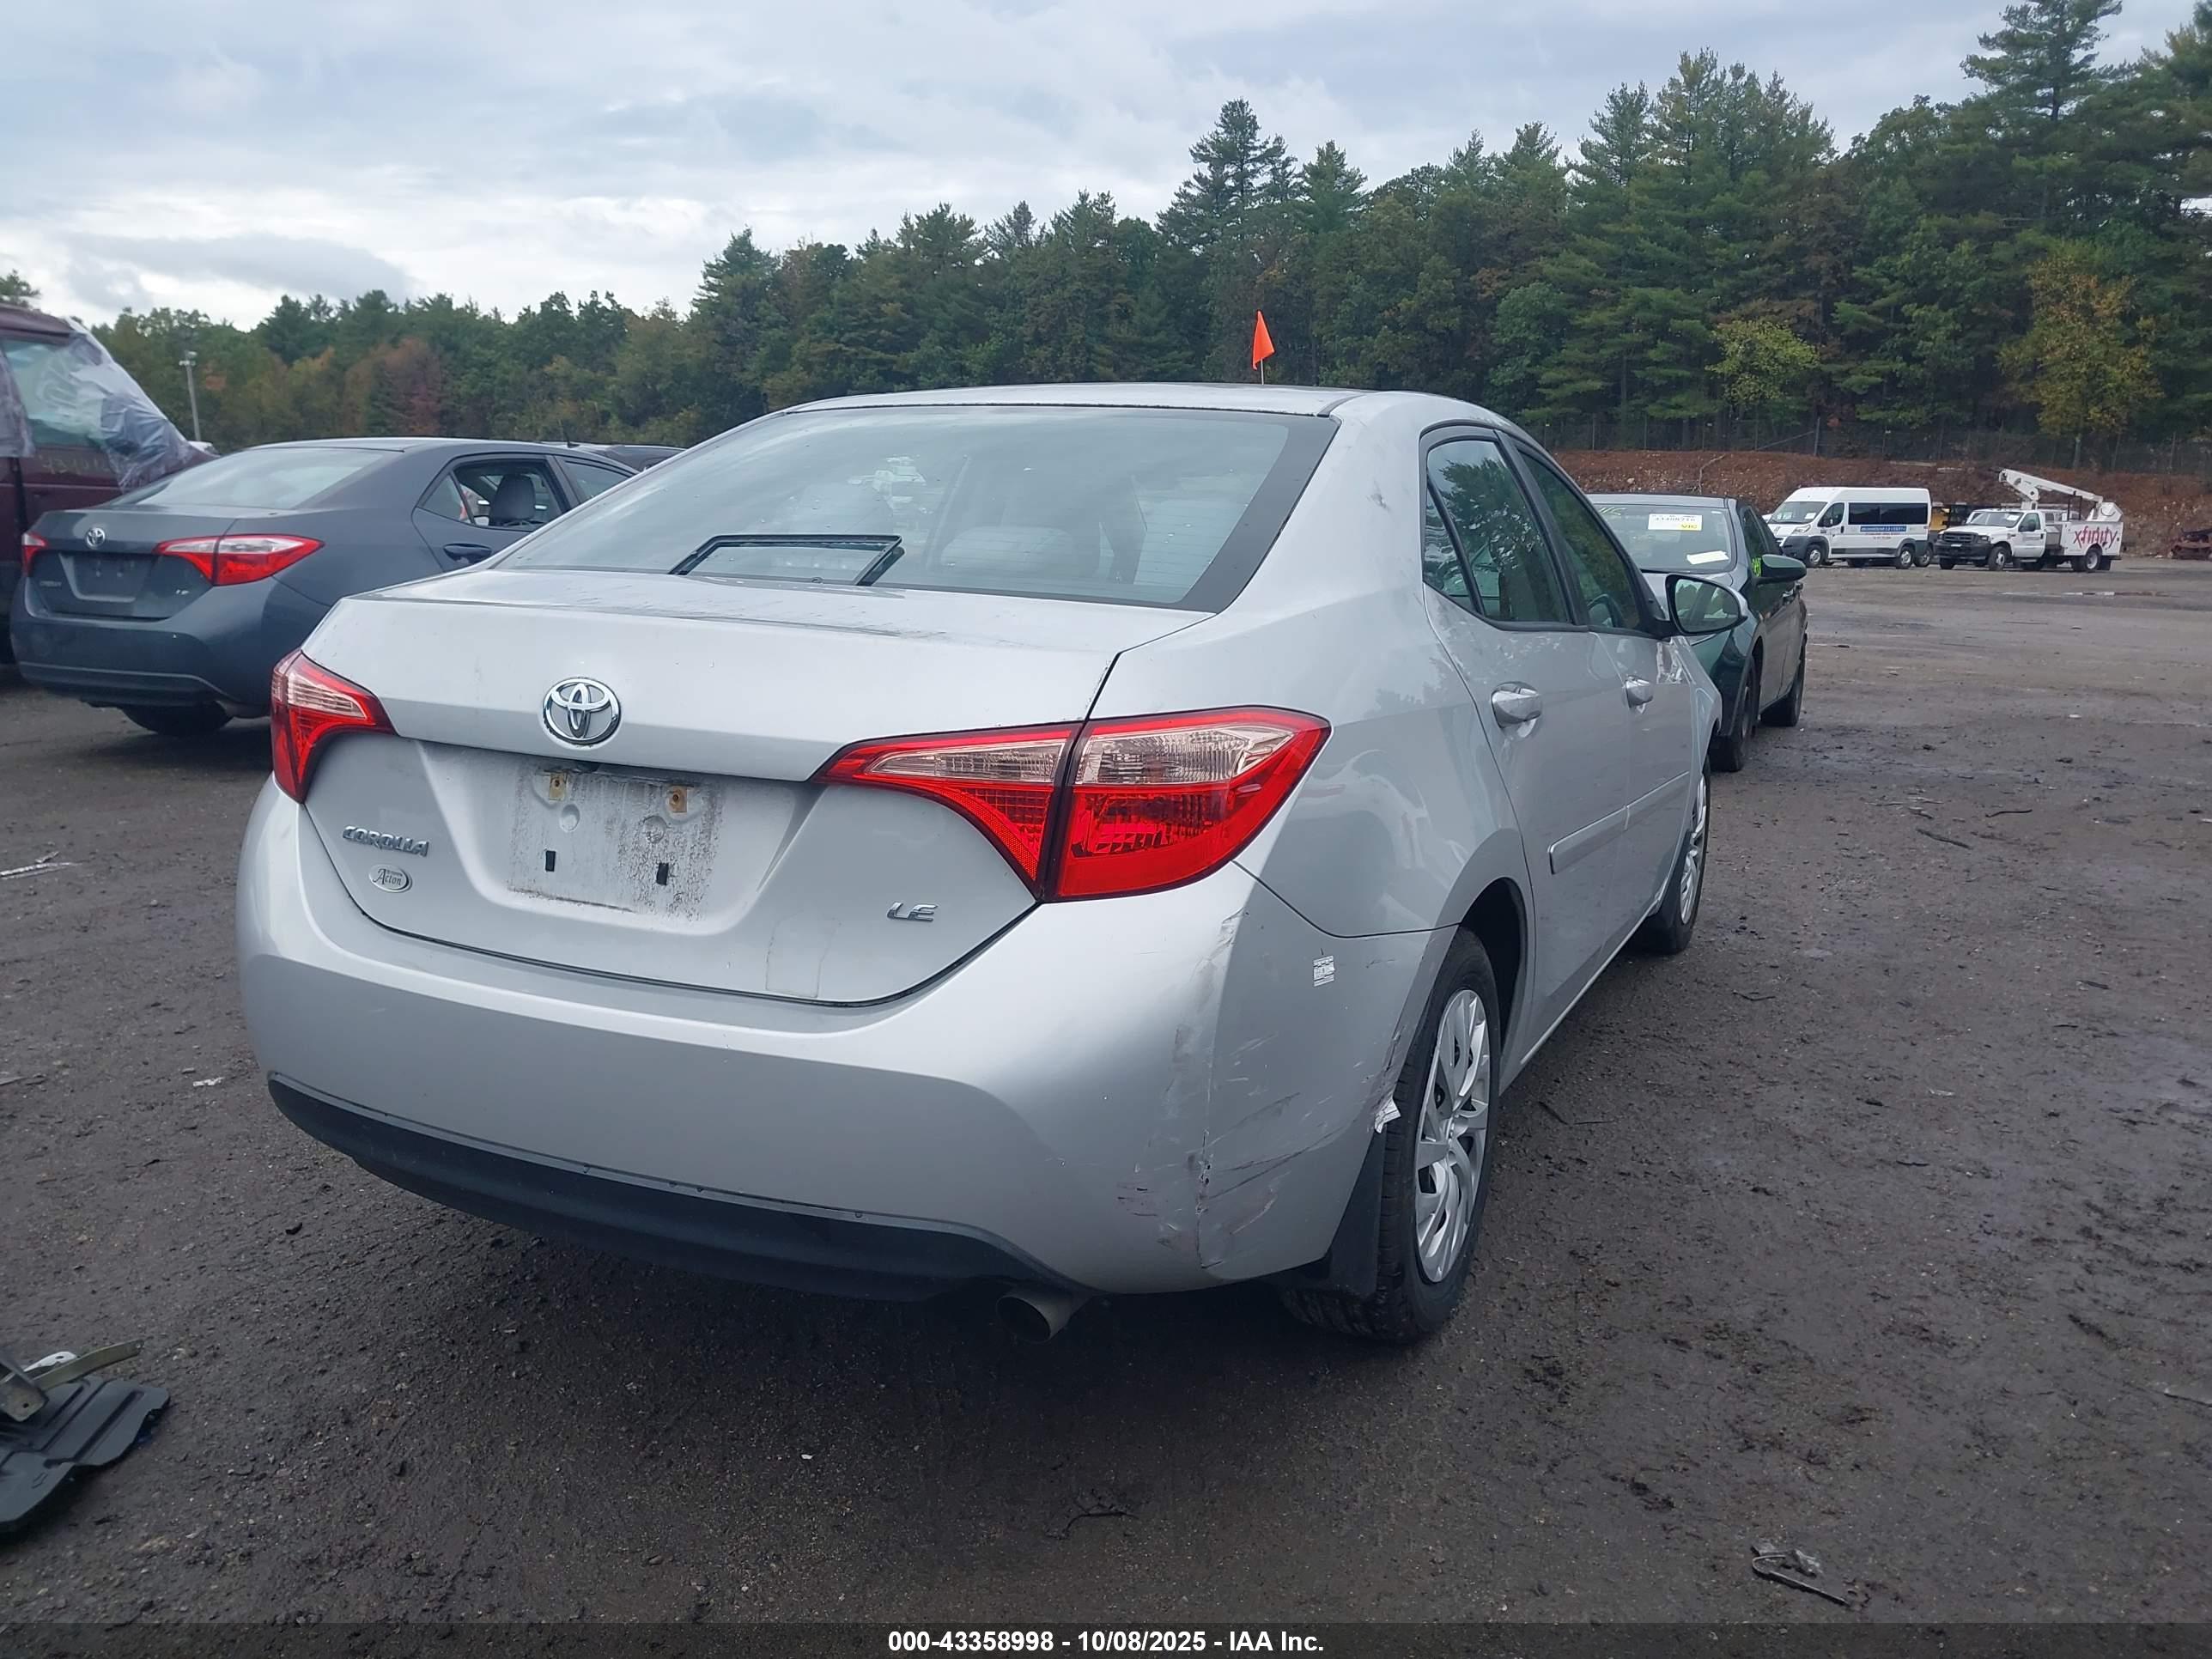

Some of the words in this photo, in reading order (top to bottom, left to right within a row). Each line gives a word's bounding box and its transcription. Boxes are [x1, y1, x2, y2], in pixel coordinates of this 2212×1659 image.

[2073, 526, 2118, 550] xfinity
[343, 825, 429, 858] COROLLA
[887, 902, 938, 922] LE
